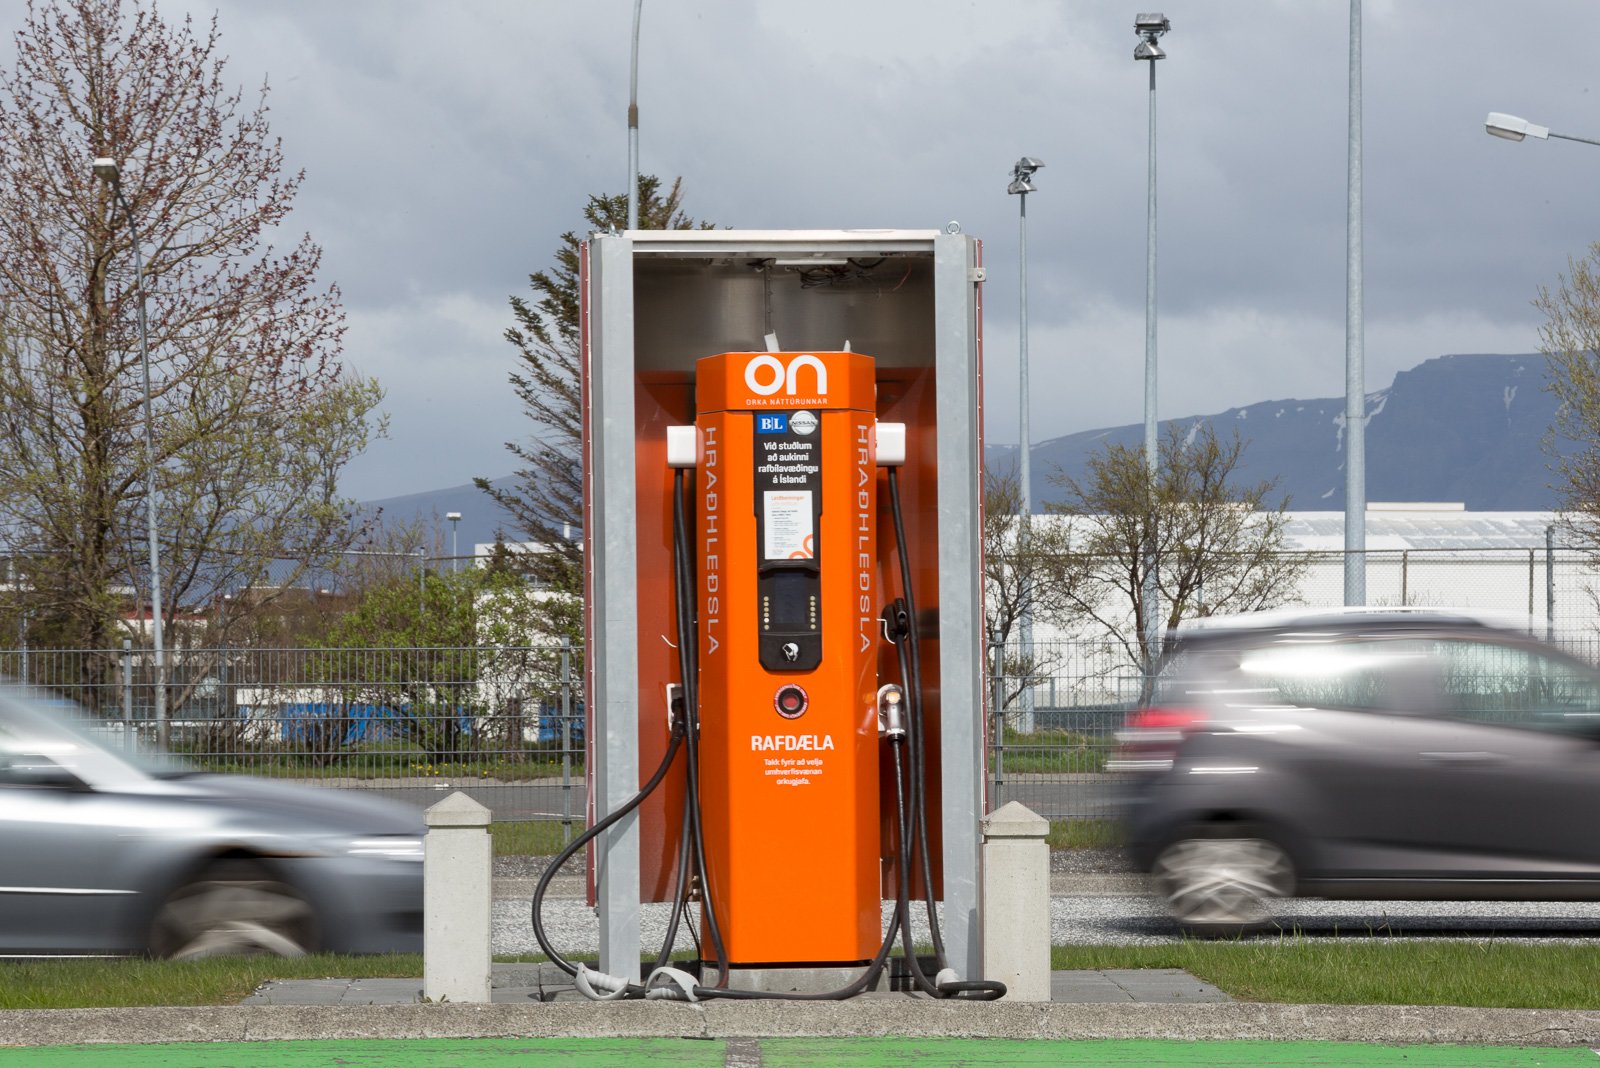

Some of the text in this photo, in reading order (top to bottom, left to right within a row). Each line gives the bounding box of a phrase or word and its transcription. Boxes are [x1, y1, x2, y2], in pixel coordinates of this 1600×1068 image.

[744, 355, 827, 396] on
[746, 397, 828, 406] ORKA NÁTTÚRUNNAR
[763, 441, 812, 450] Við stuðlum
[767, 453, 809, 461] að aukinni
[772, 474, 807, 484] á Íslandi
[706, 427, 719, 654] HRAÐHLEÐSLA
[858, 425, 870, 653] HRAÐHLEÐSLA
[751, 735, 835, 751] RAFDÆLA
[781, 758, 796, 767] fyrir
[796, 758, 806, 766] að
[806, 758, 823, 767] velja
